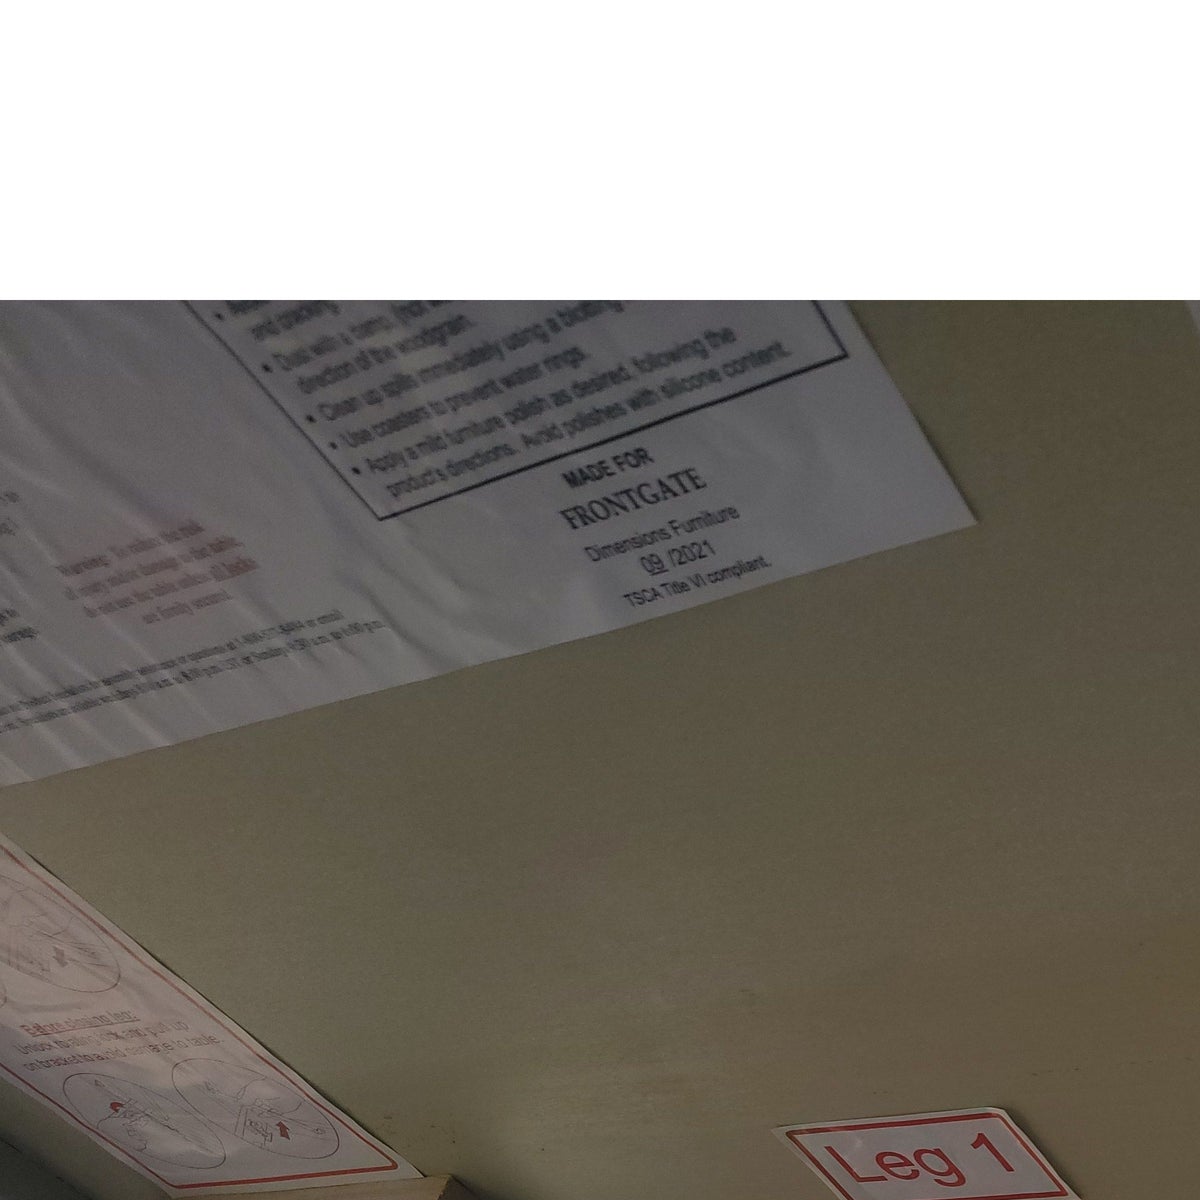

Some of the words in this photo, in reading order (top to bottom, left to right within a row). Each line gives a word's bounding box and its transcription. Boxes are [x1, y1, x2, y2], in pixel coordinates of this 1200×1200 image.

[352, 352, 373, 370] of
[368, 344, 396, 364] the
[318, 394, 362, 420] Clean
[341, 427, 373, 447] Use
[371, 407, 431, 436] coasters
[428, 400, 446, 415] to
[443, 380, 503, 412] prevent
[499, 365, 543, 388] water
[366, 450, 407, 475] Apply
[443, 413, 504, 445] furniture
[502, 396, 551, 423] polish
[632, 337, 710, 378] following
[702, 325, 736, 348] the
[521, 425, 562, 448] Avoid
[560, 401, 626, 434] polishes
[623, 388, 660, 411] with
[657, 365, 721, 398] silicone
[561, 460, 616, 488] MADE
[611, 447, 655, 472] FOR
[559, 467, 708, 530] FRONTGATE
[583, 527, 672, 562] Dimensions
[667, 505, 740, 536] Furniture
[639, 553, 668, 576] 09
[667, 539, 716, 567] /2021
[622, 586, 663, 608] TSCA
[661, 580, 691, 597] Title
[688, 573, 707, 590] VI
[707, 555, 772, 583] compliant.
[20, 1022, 63, 1037] Before
[64, 1014, 107, 1029] closing
[823, 1145, 967, 1188] Leg
[970, 1132, 1016, 1173] 1
